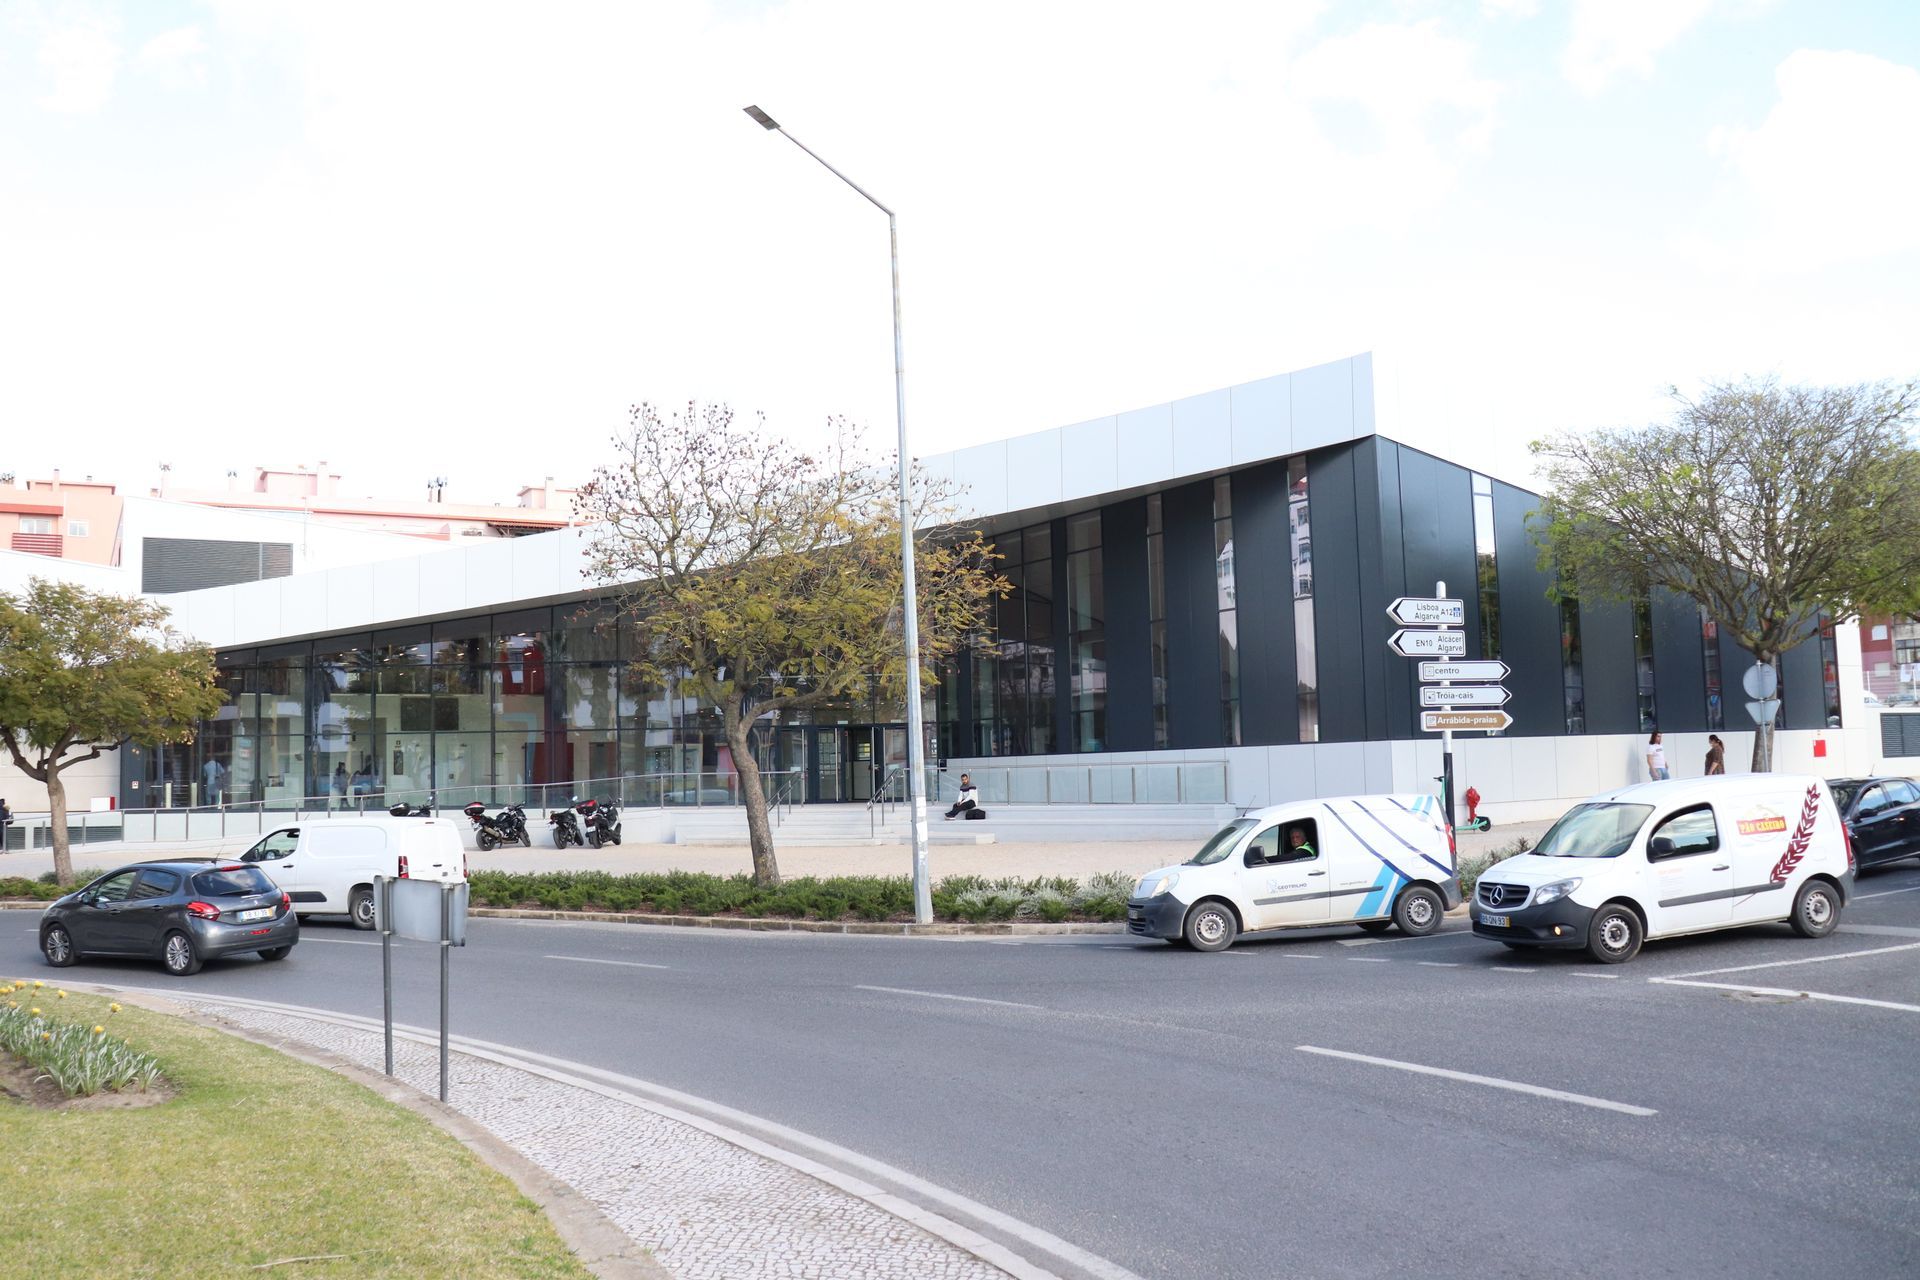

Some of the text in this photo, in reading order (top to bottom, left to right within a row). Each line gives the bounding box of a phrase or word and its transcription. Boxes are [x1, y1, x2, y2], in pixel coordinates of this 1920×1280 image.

[1416, 603, 1439, 611] Lisboa
[1440, 608, 1453, 616] A12
[1414, 612, 1440, 621] Algarve
[1415, 639, 1433, 647] EN10
[1437, 644, 1463, 653] Algarve
[1436, 691, 1474, 699] Tróia-cais
[1437, 715, 1498, 725] Arrábida-praias
